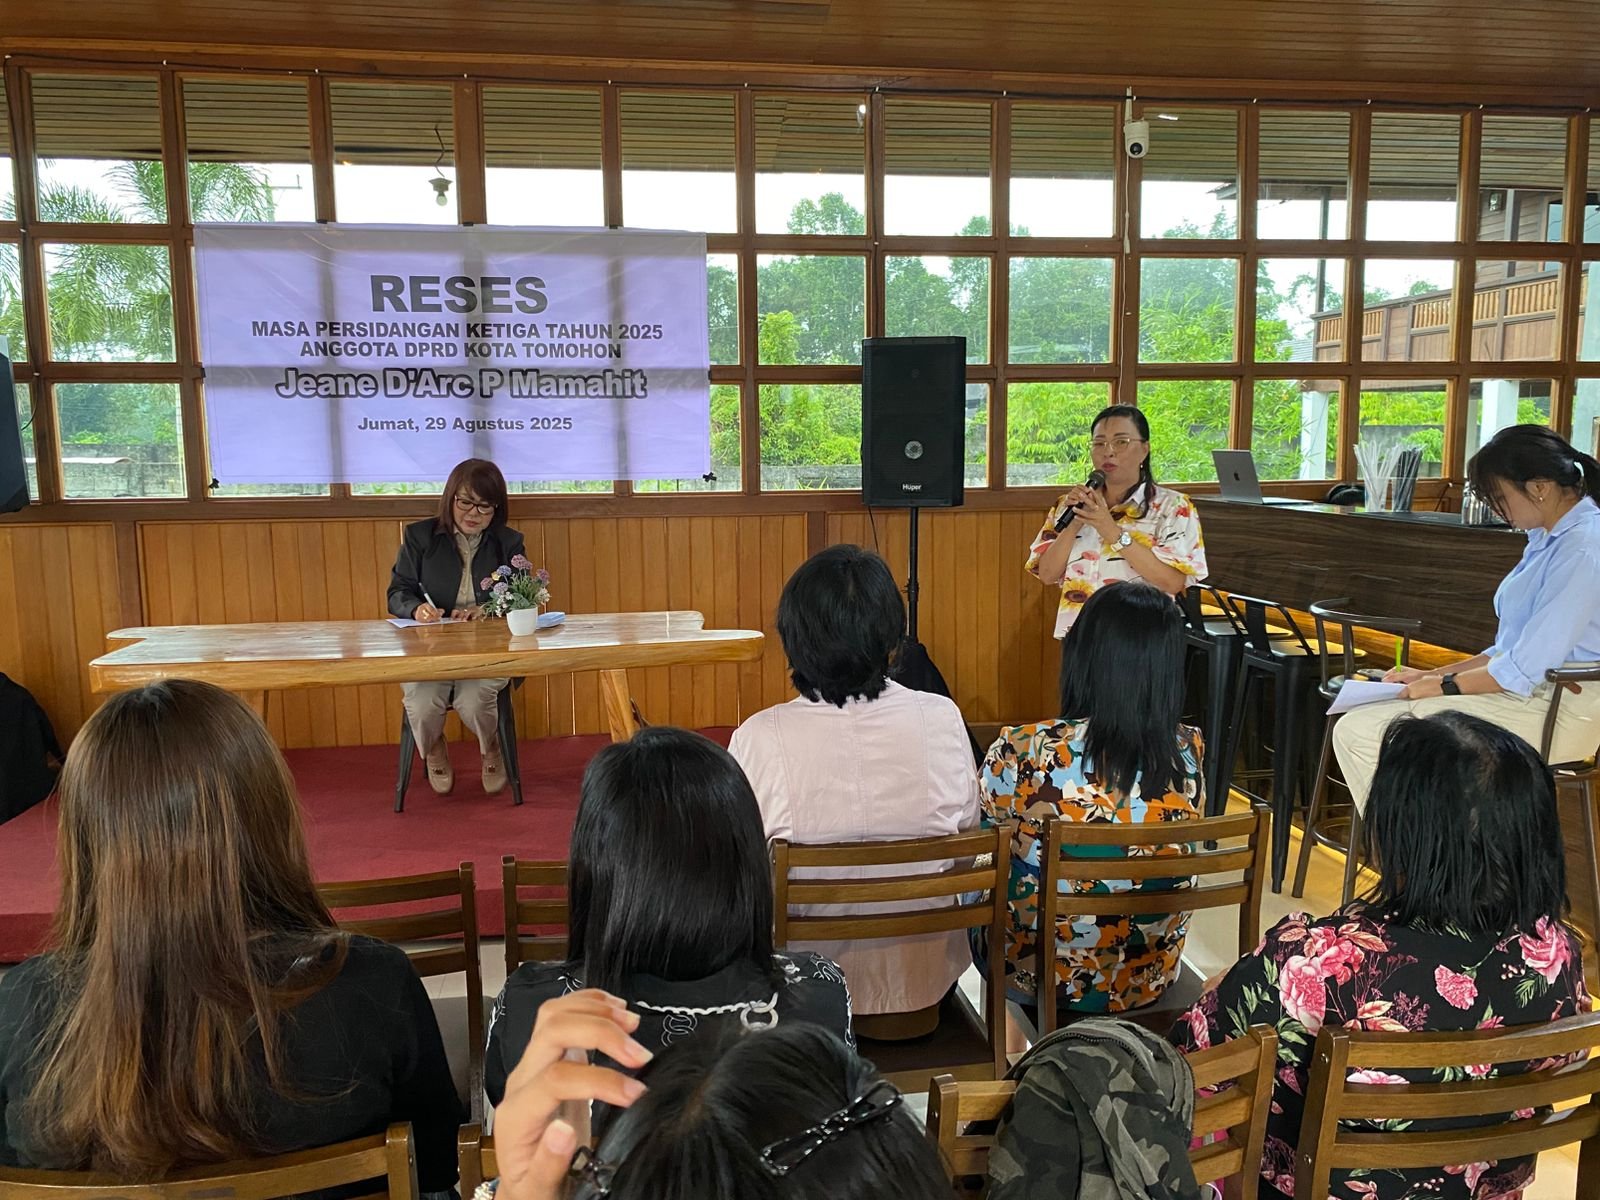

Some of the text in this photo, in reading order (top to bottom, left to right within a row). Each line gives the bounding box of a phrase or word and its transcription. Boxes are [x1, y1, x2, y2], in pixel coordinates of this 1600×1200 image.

[370, 274, 548, 314] RESES
[252, 320, 663, 340] MASA PERSIDANGAN KETIGA TAHUN 2025
[300, 341, 622, 359] ANGGOTA DPRD KOTA TOMOHON
[275, 367, 647, 399] Jeane D'Arc P Mamahit
[357, 417, 573, 433] Jumat, 29 Agustus 2025
